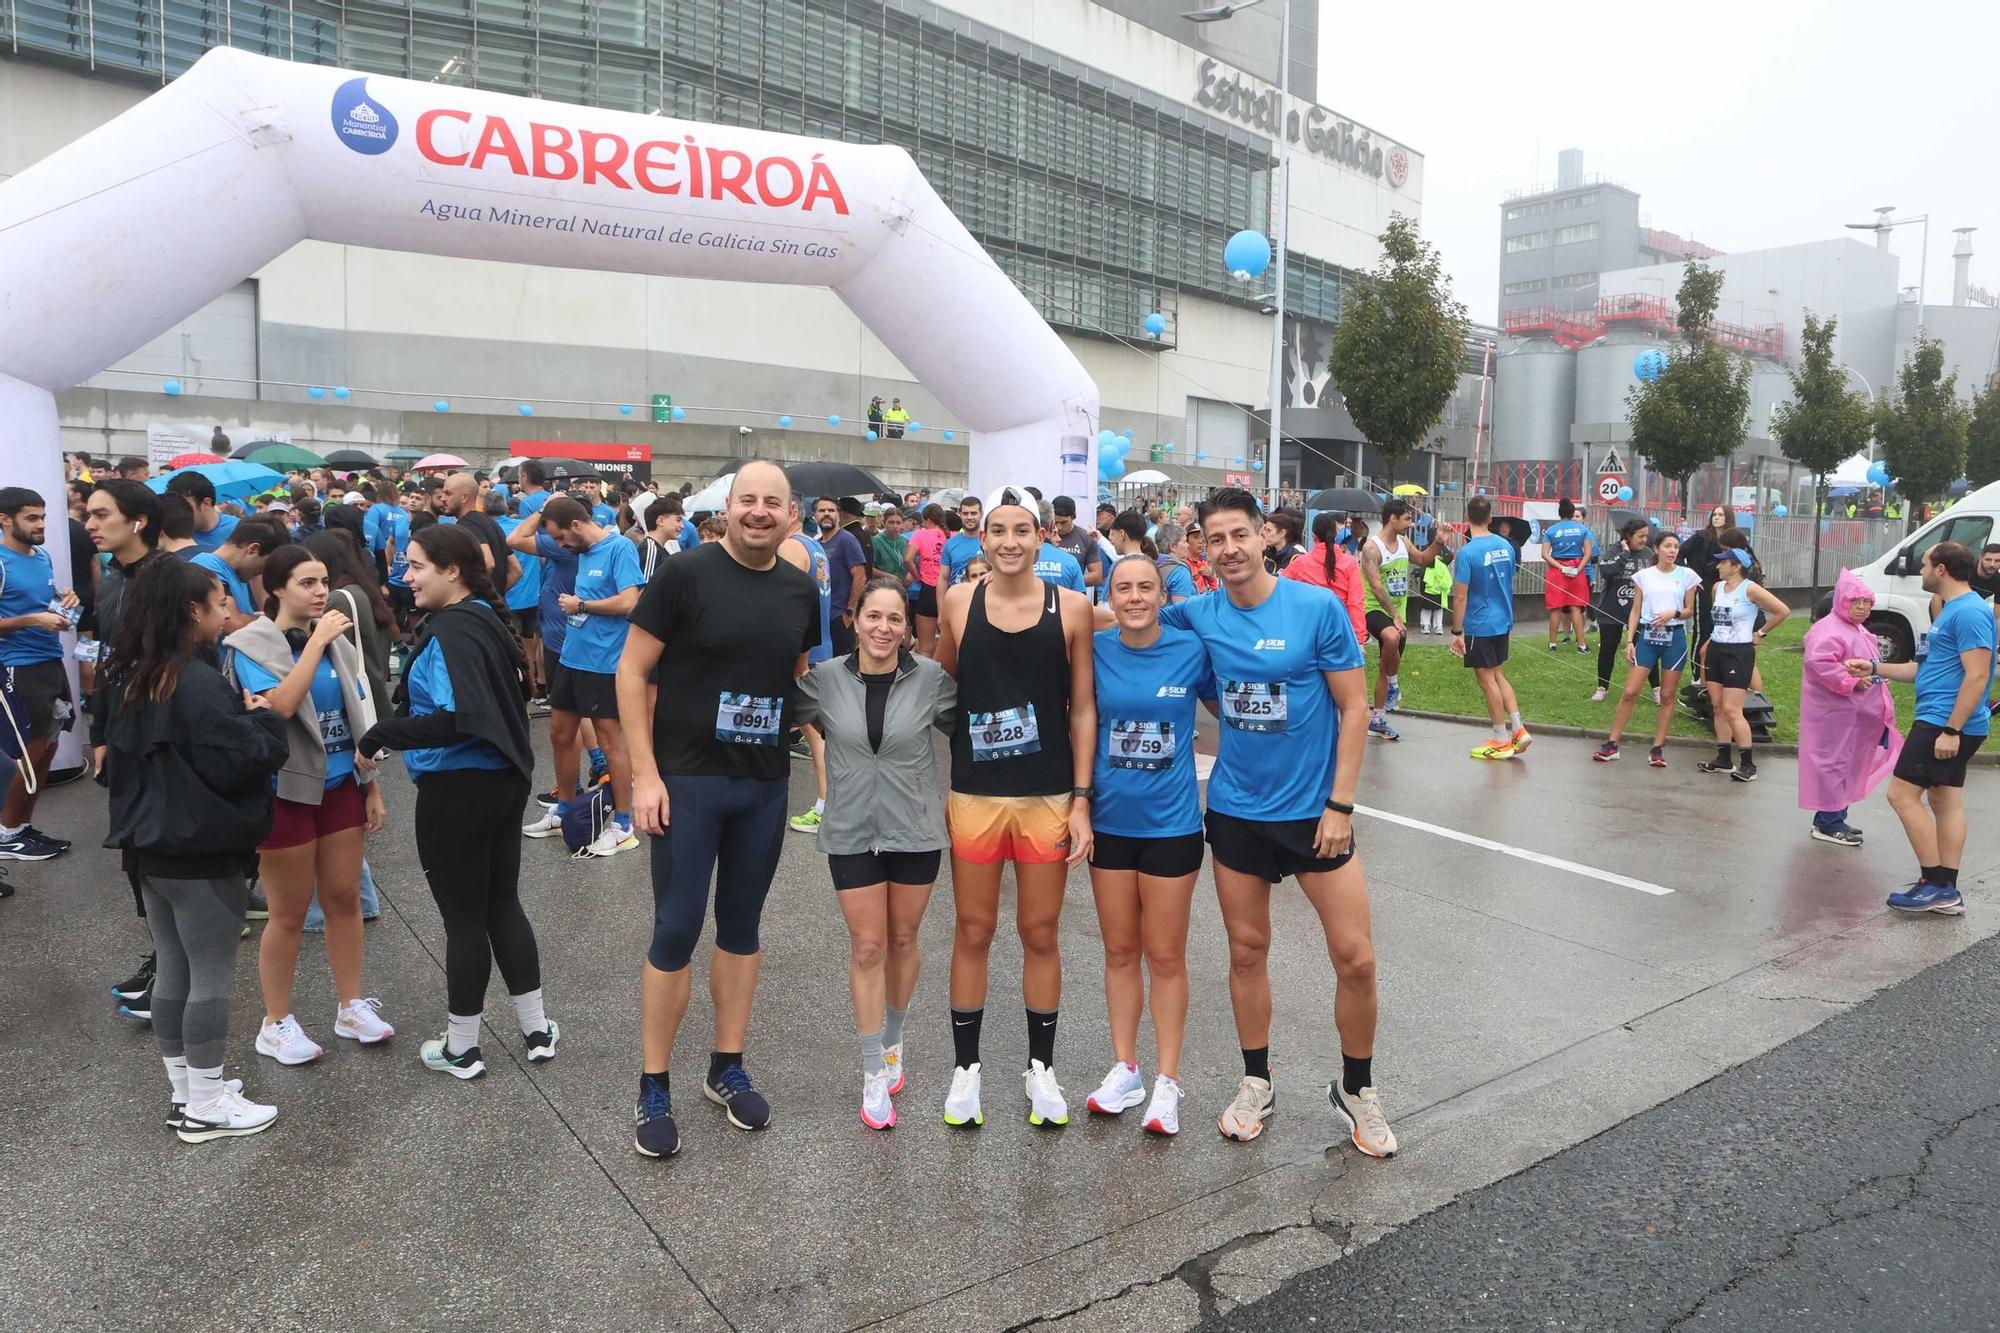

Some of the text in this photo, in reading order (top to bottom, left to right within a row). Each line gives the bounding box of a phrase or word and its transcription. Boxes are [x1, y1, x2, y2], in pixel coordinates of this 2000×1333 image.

[343, 119, 387, 132] Manantial
[1192, 57, 1382, 178] Estrella Galicia
[420, 199, 838, 258] Agua Mineral Natural de Galicia Sin Gas
[1602, 483, 1618, 495] 20
[1169, 686, 1187, 694] 5KM
[1234, 700, 1272, 715] 0225
[733, 712, 769, 729] 0991
[983, 726, 1023, 744] 0228
[1121, 738, 1162, 754] 0759
